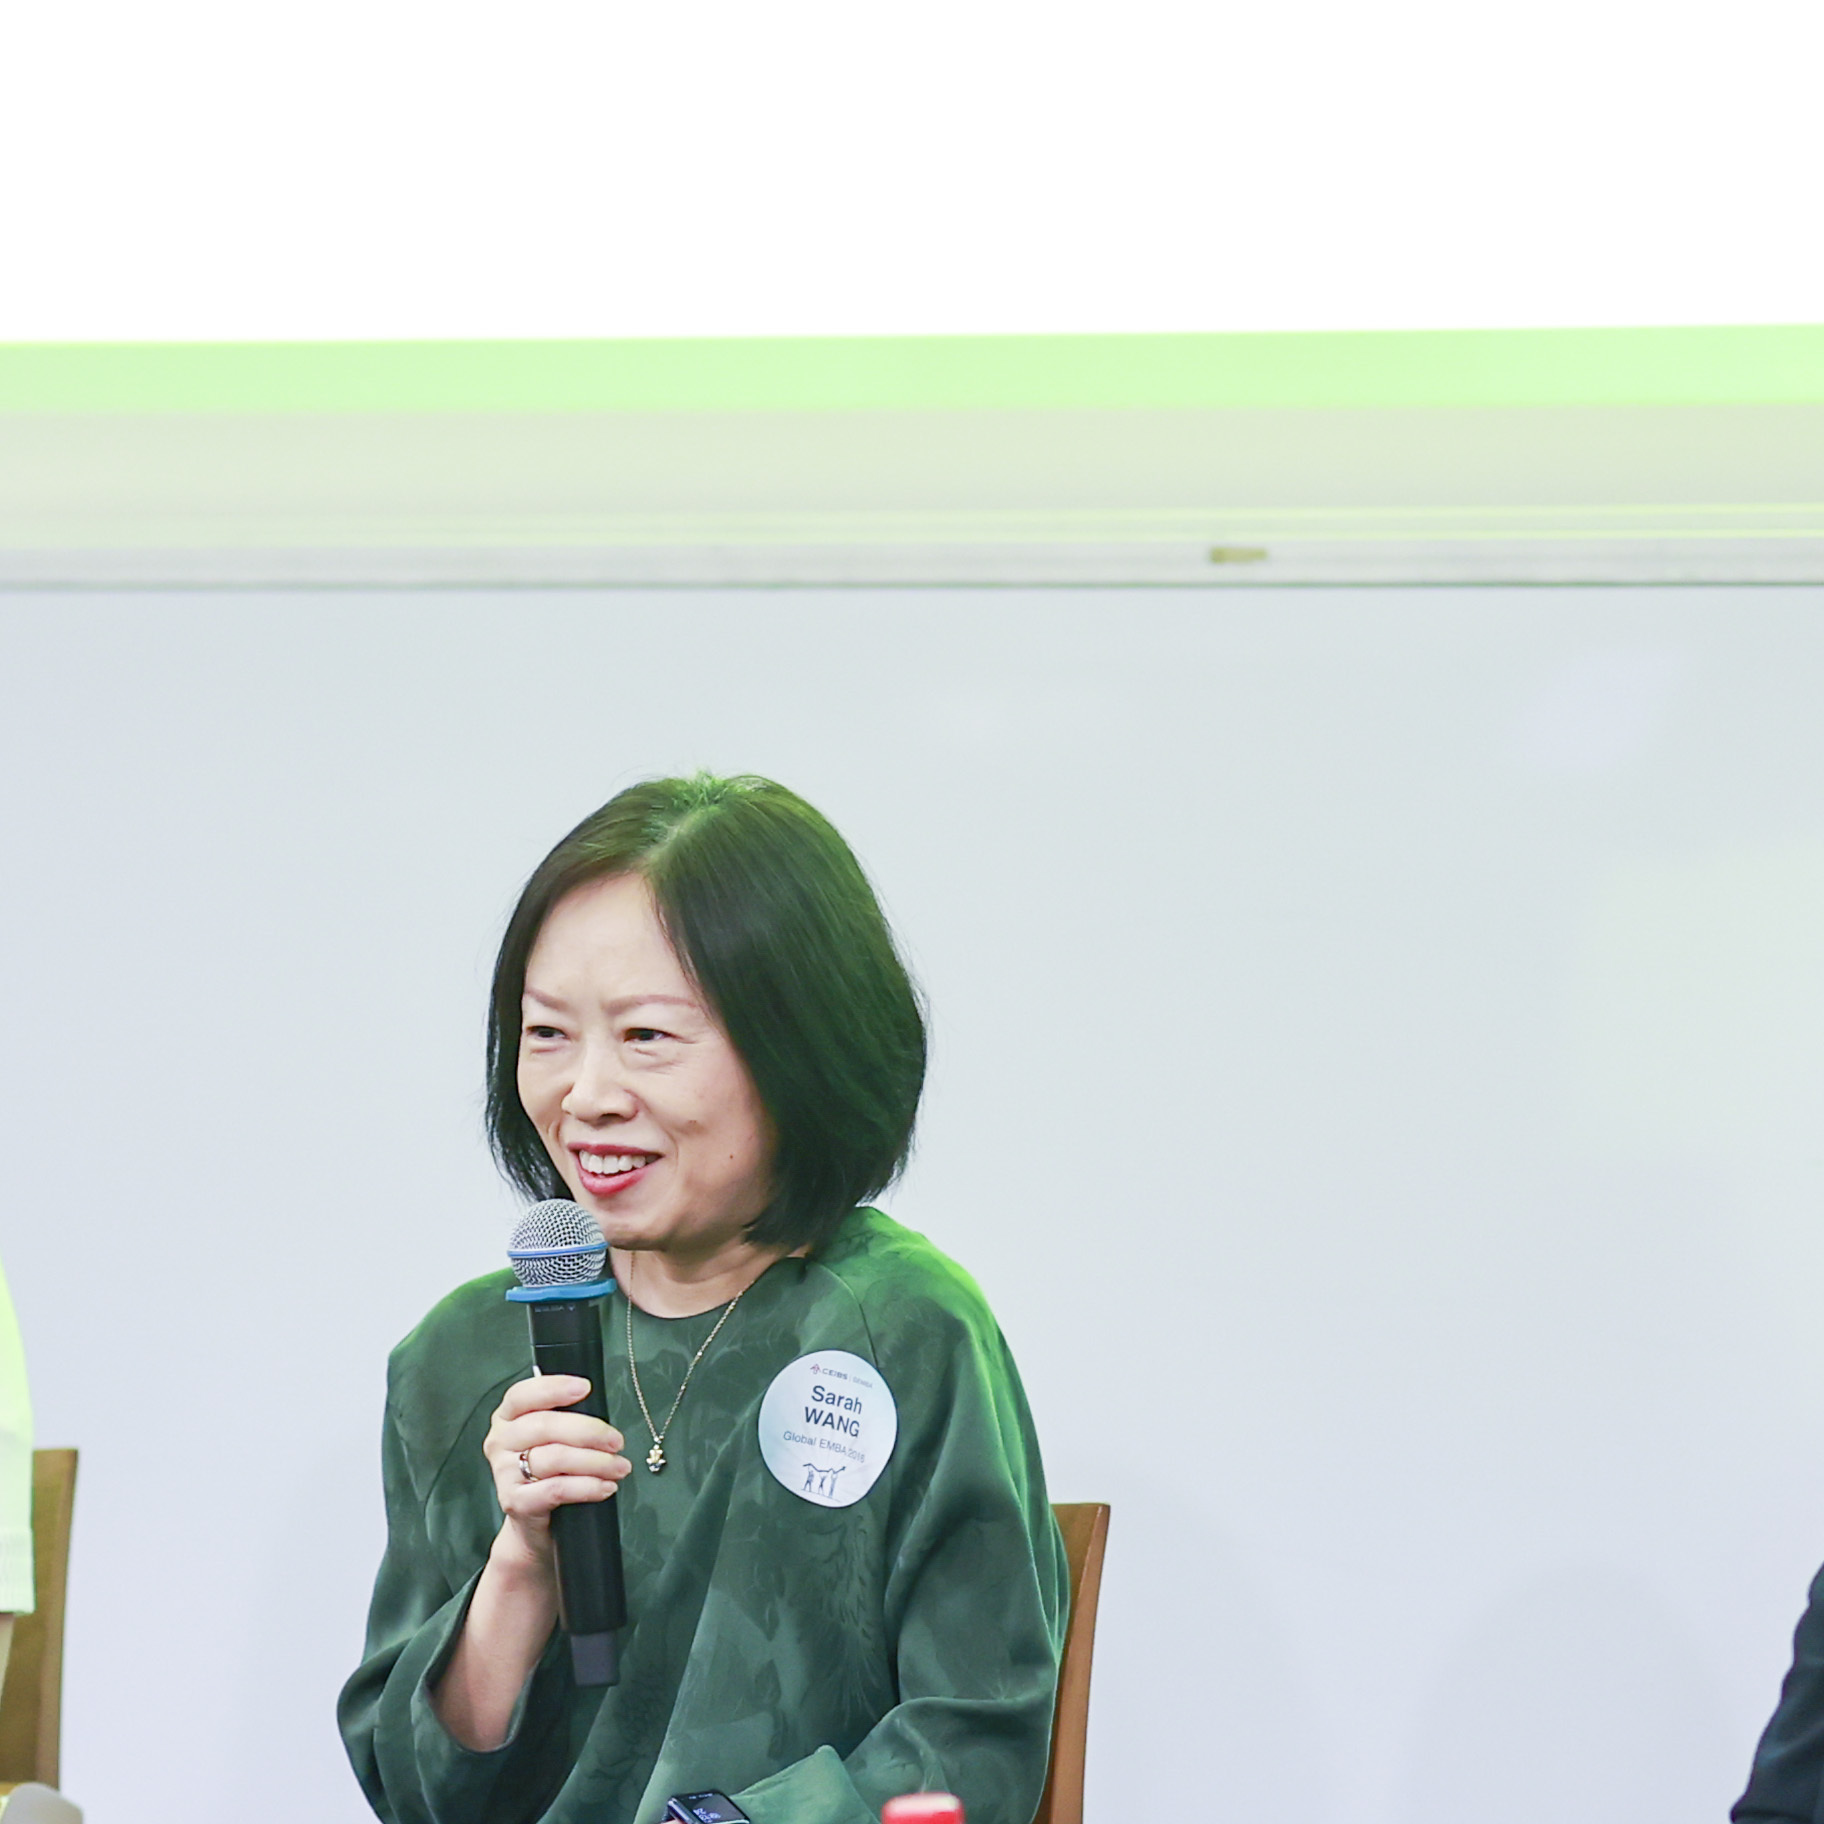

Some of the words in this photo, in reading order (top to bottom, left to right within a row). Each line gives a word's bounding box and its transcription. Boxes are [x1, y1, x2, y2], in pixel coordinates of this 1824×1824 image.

[811, 1385, 862, 1415] Sarah
[804, 1406, 860, 1438] WANG
[783, 1430, 817, 1446] Global
